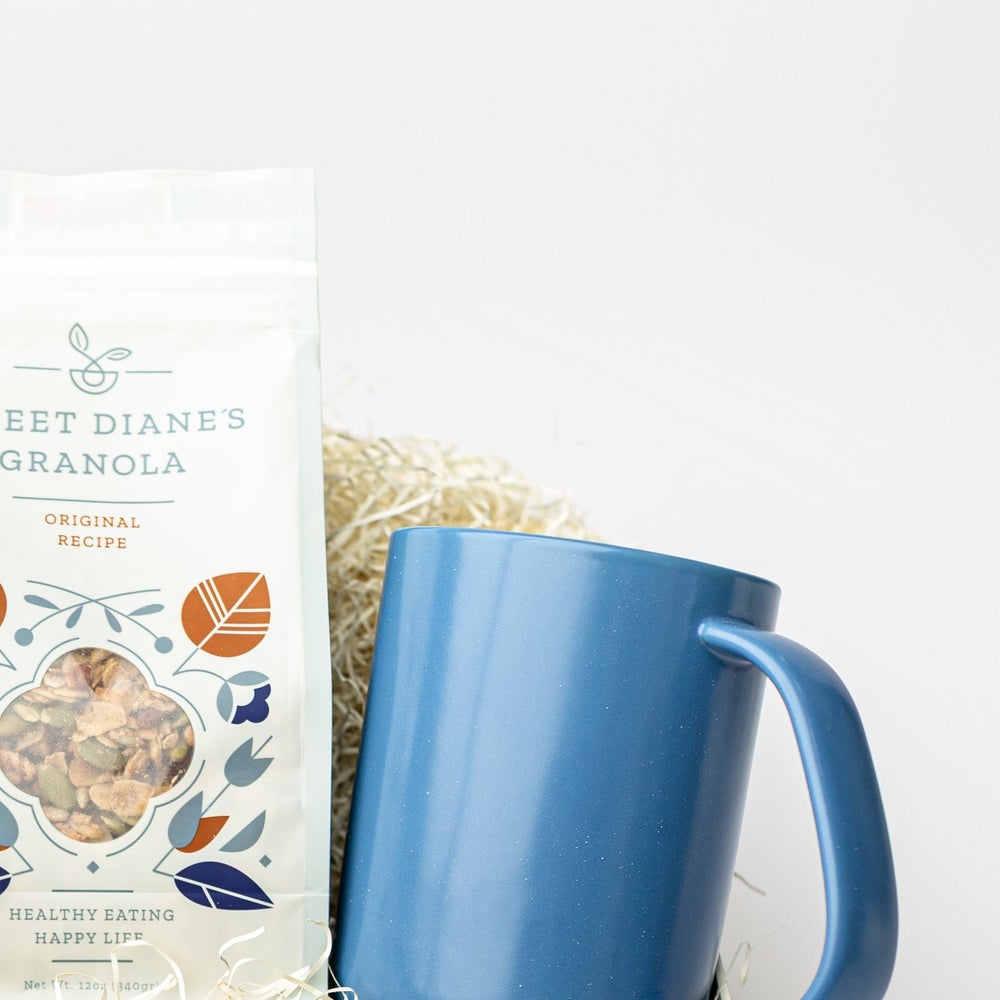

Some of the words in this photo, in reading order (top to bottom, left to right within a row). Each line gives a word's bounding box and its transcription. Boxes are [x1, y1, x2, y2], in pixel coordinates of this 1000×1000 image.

[0, 449, 187, 476] GRANOLA
[44, 513, 141, 529] ORIGINAL
[57, 534, 128, 549] RECIPE
[8, 908, 98, 921] HEALTHY
[104, 908, 175, 921] EATING
[35, 931, 97, 945] HAPPY
[24, 980, 47, 991] Net
